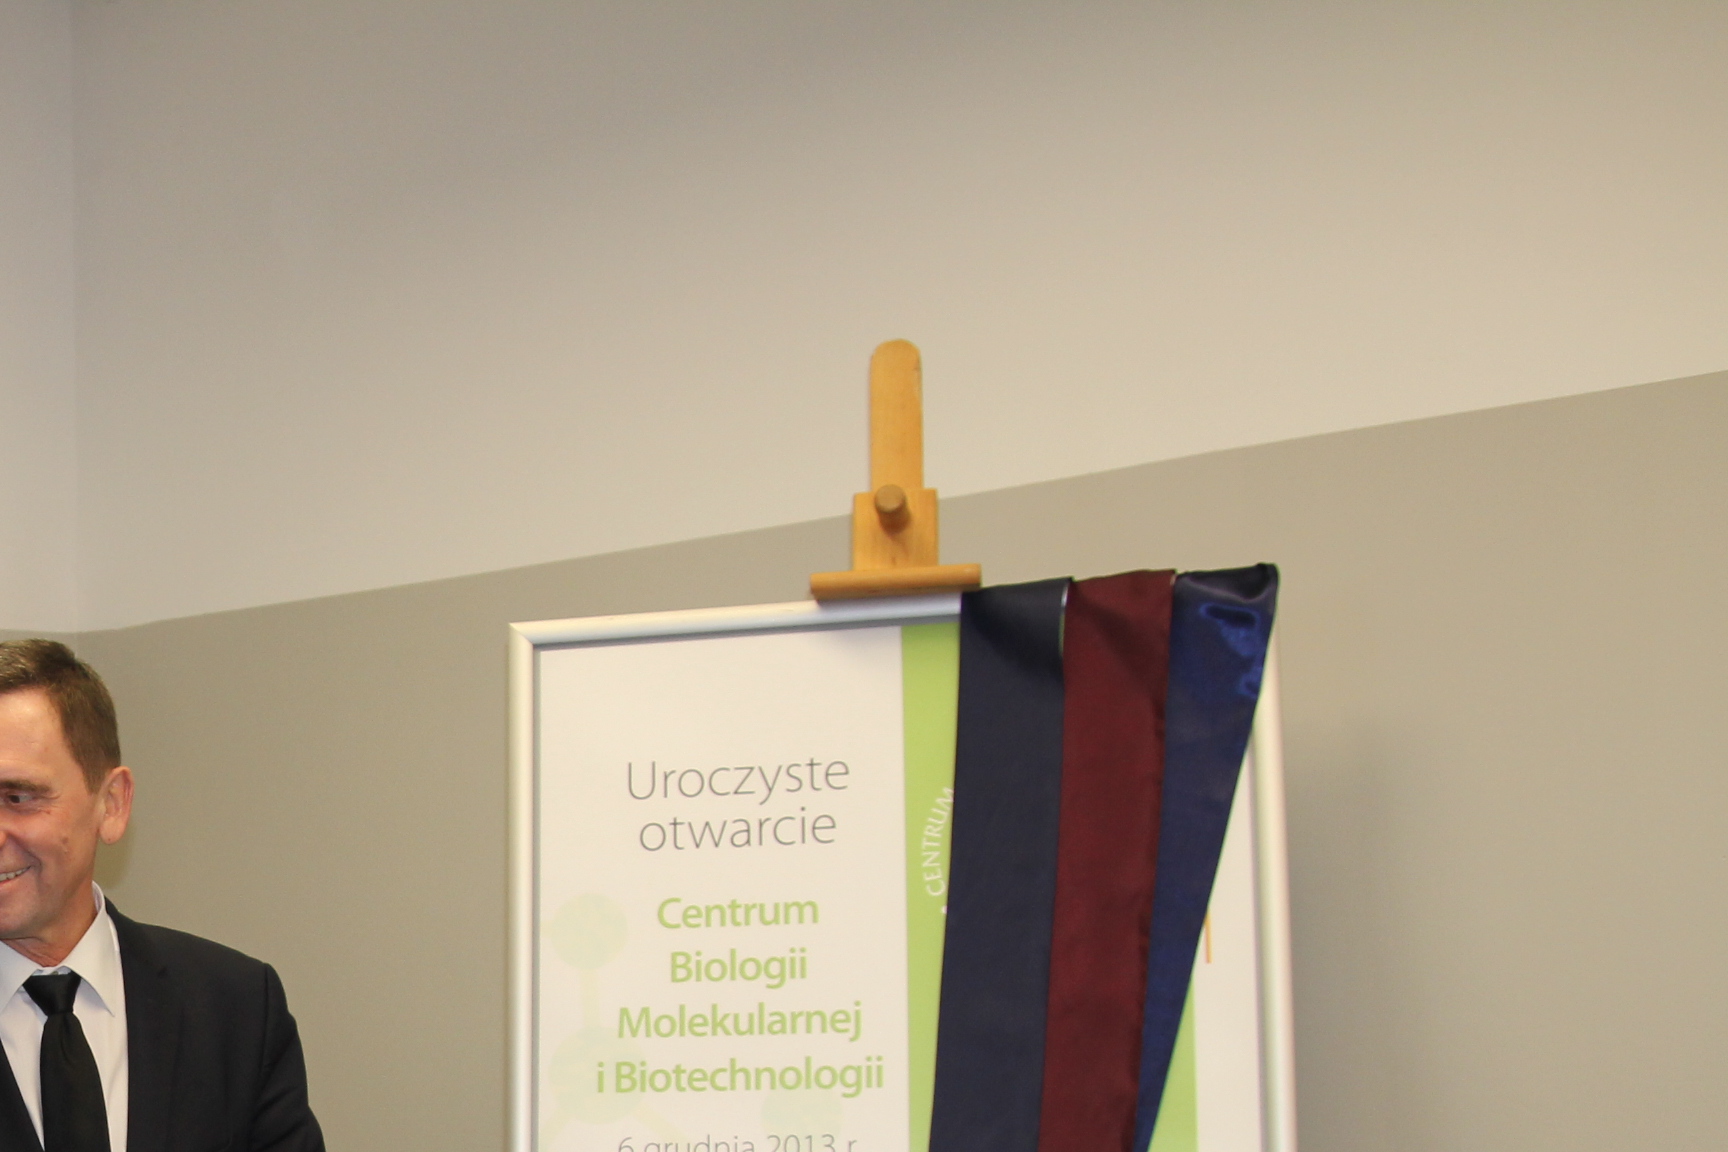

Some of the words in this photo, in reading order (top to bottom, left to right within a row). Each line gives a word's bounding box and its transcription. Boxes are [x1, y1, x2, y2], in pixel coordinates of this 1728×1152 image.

[627, 757, 850, 806] Uroczyste
[639, 808, 838, 852] otwarcie
[657, 897, 820, 930] Centrum
[670, 947, 808, 990] Biologii
[618, 1000, 862, 1042] Molekularnej
[597, 1061, 605, 1093] i
[615, 1055, 884, 1099] Biotechnologii
